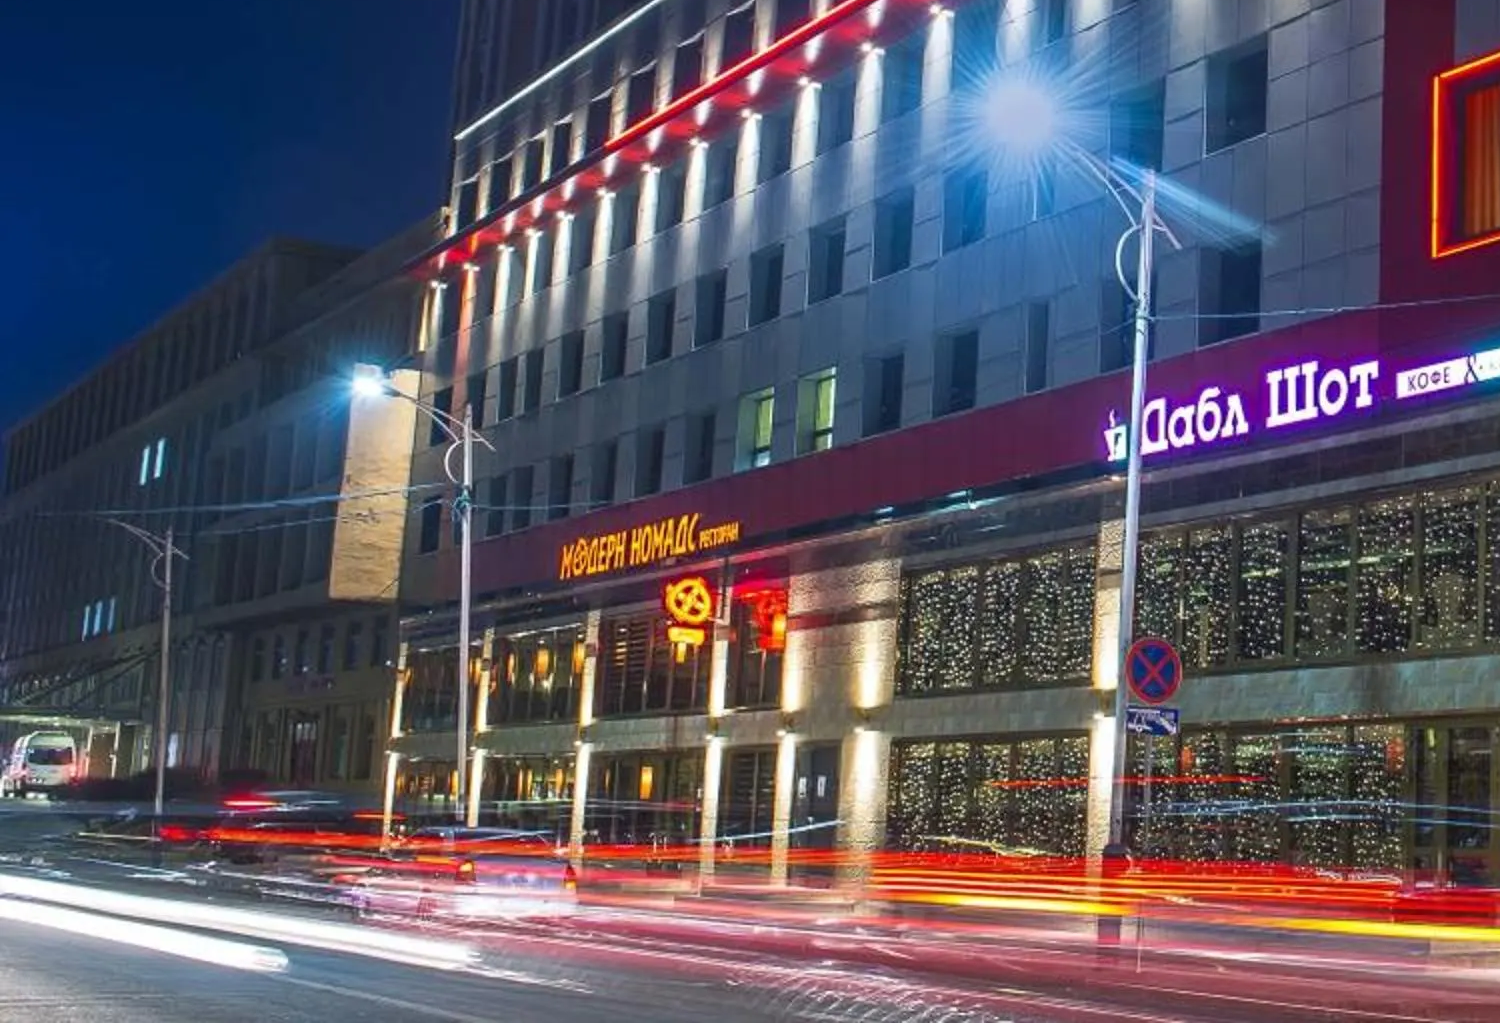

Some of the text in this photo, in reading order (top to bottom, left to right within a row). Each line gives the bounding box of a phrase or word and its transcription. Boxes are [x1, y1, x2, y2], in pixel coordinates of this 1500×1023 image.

[1265, 360, 1380, 428] Шот
[1406, 366, 1452, 393] КОФЕ
[629, 512, 702, 566] НОМАДС
